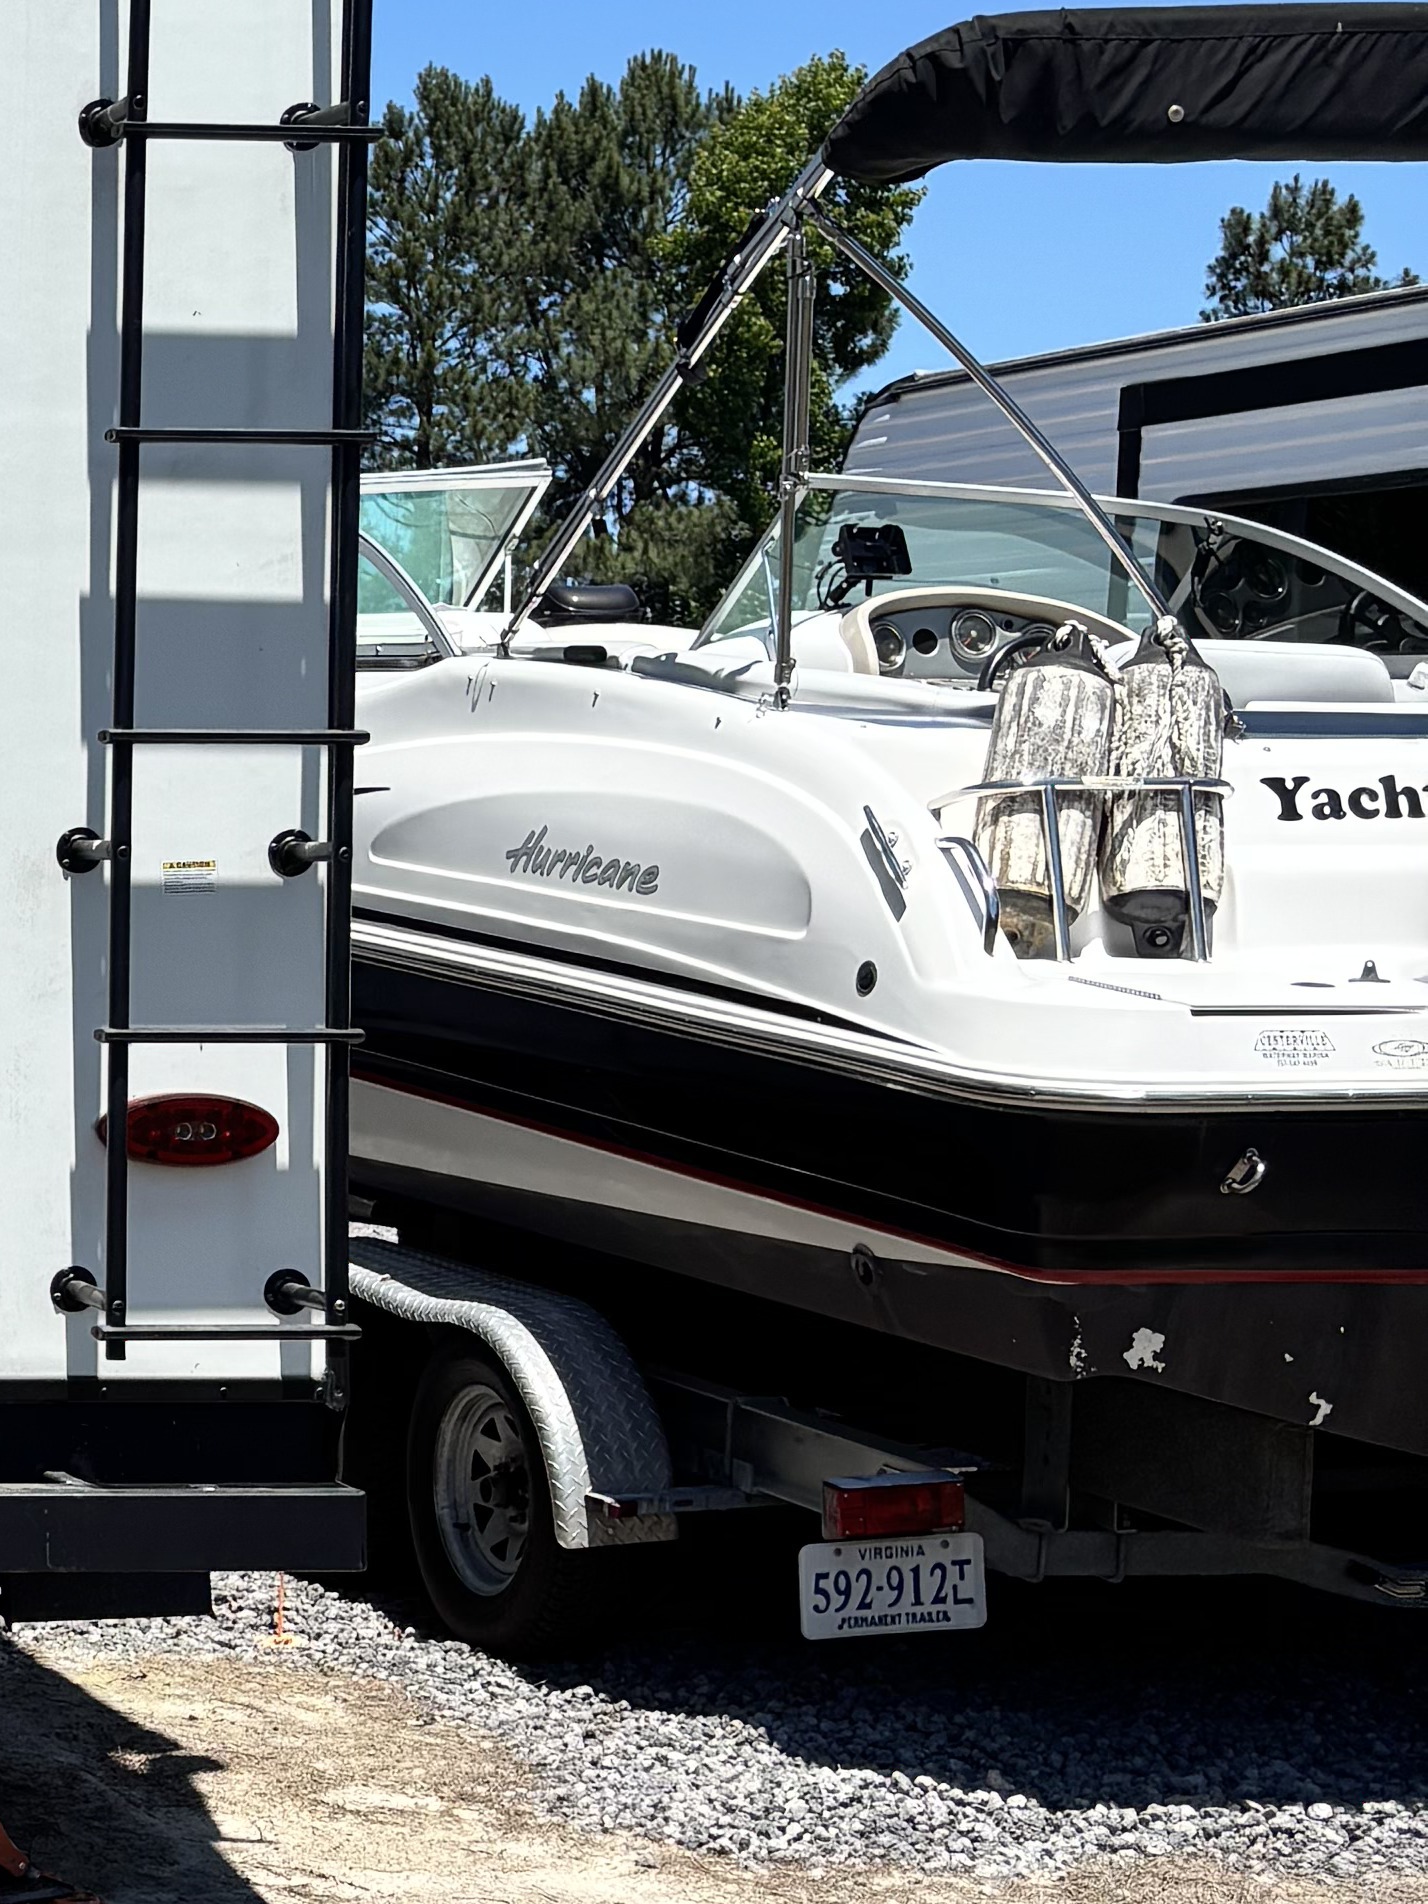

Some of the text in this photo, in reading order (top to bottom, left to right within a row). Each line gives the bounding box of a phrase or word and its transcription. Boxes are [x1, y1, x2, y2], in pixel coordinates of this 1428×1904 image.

[1258, 774, 1428, 822] Yach
[505, 824, 661, 896] Hurricane
[857, 1544, 926, 1561] VIRGINIA
[837, 1610, 952, 1630] PERMANENT TRAILER
